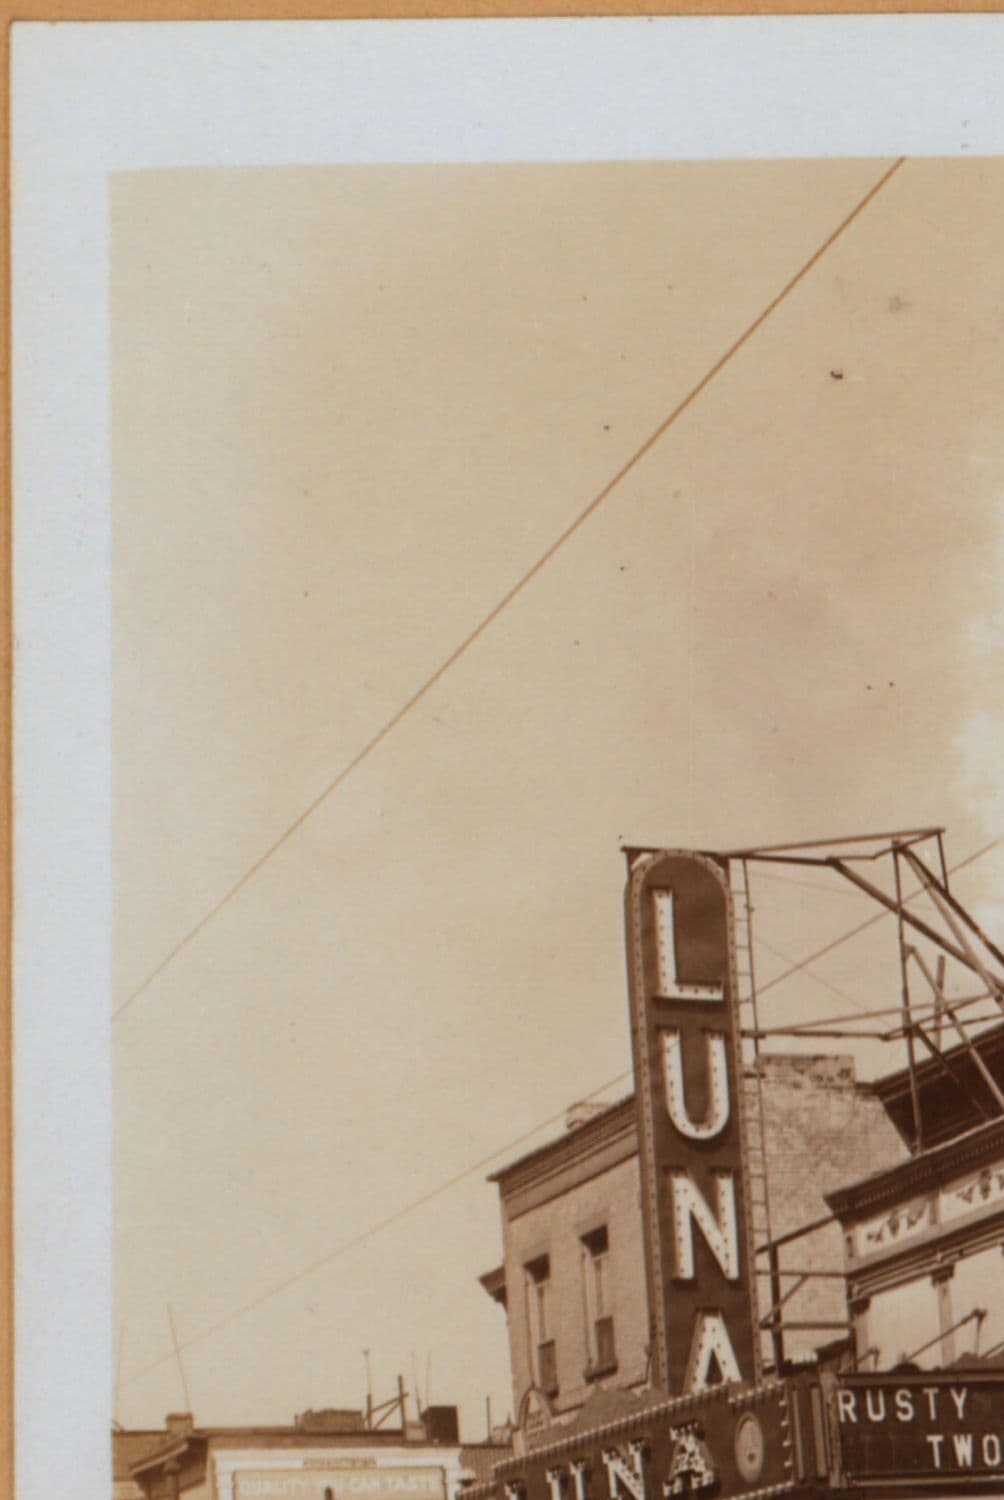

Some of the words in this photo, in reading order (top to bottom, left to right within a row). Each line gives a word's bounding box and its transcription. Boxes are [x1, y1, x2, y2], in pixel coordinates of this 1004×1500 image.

[654, 887, 743, 1391] LUNA
[838, 1387, 967, 1424] RUSTY
[926, 1434, 1001, 1469] TWO
